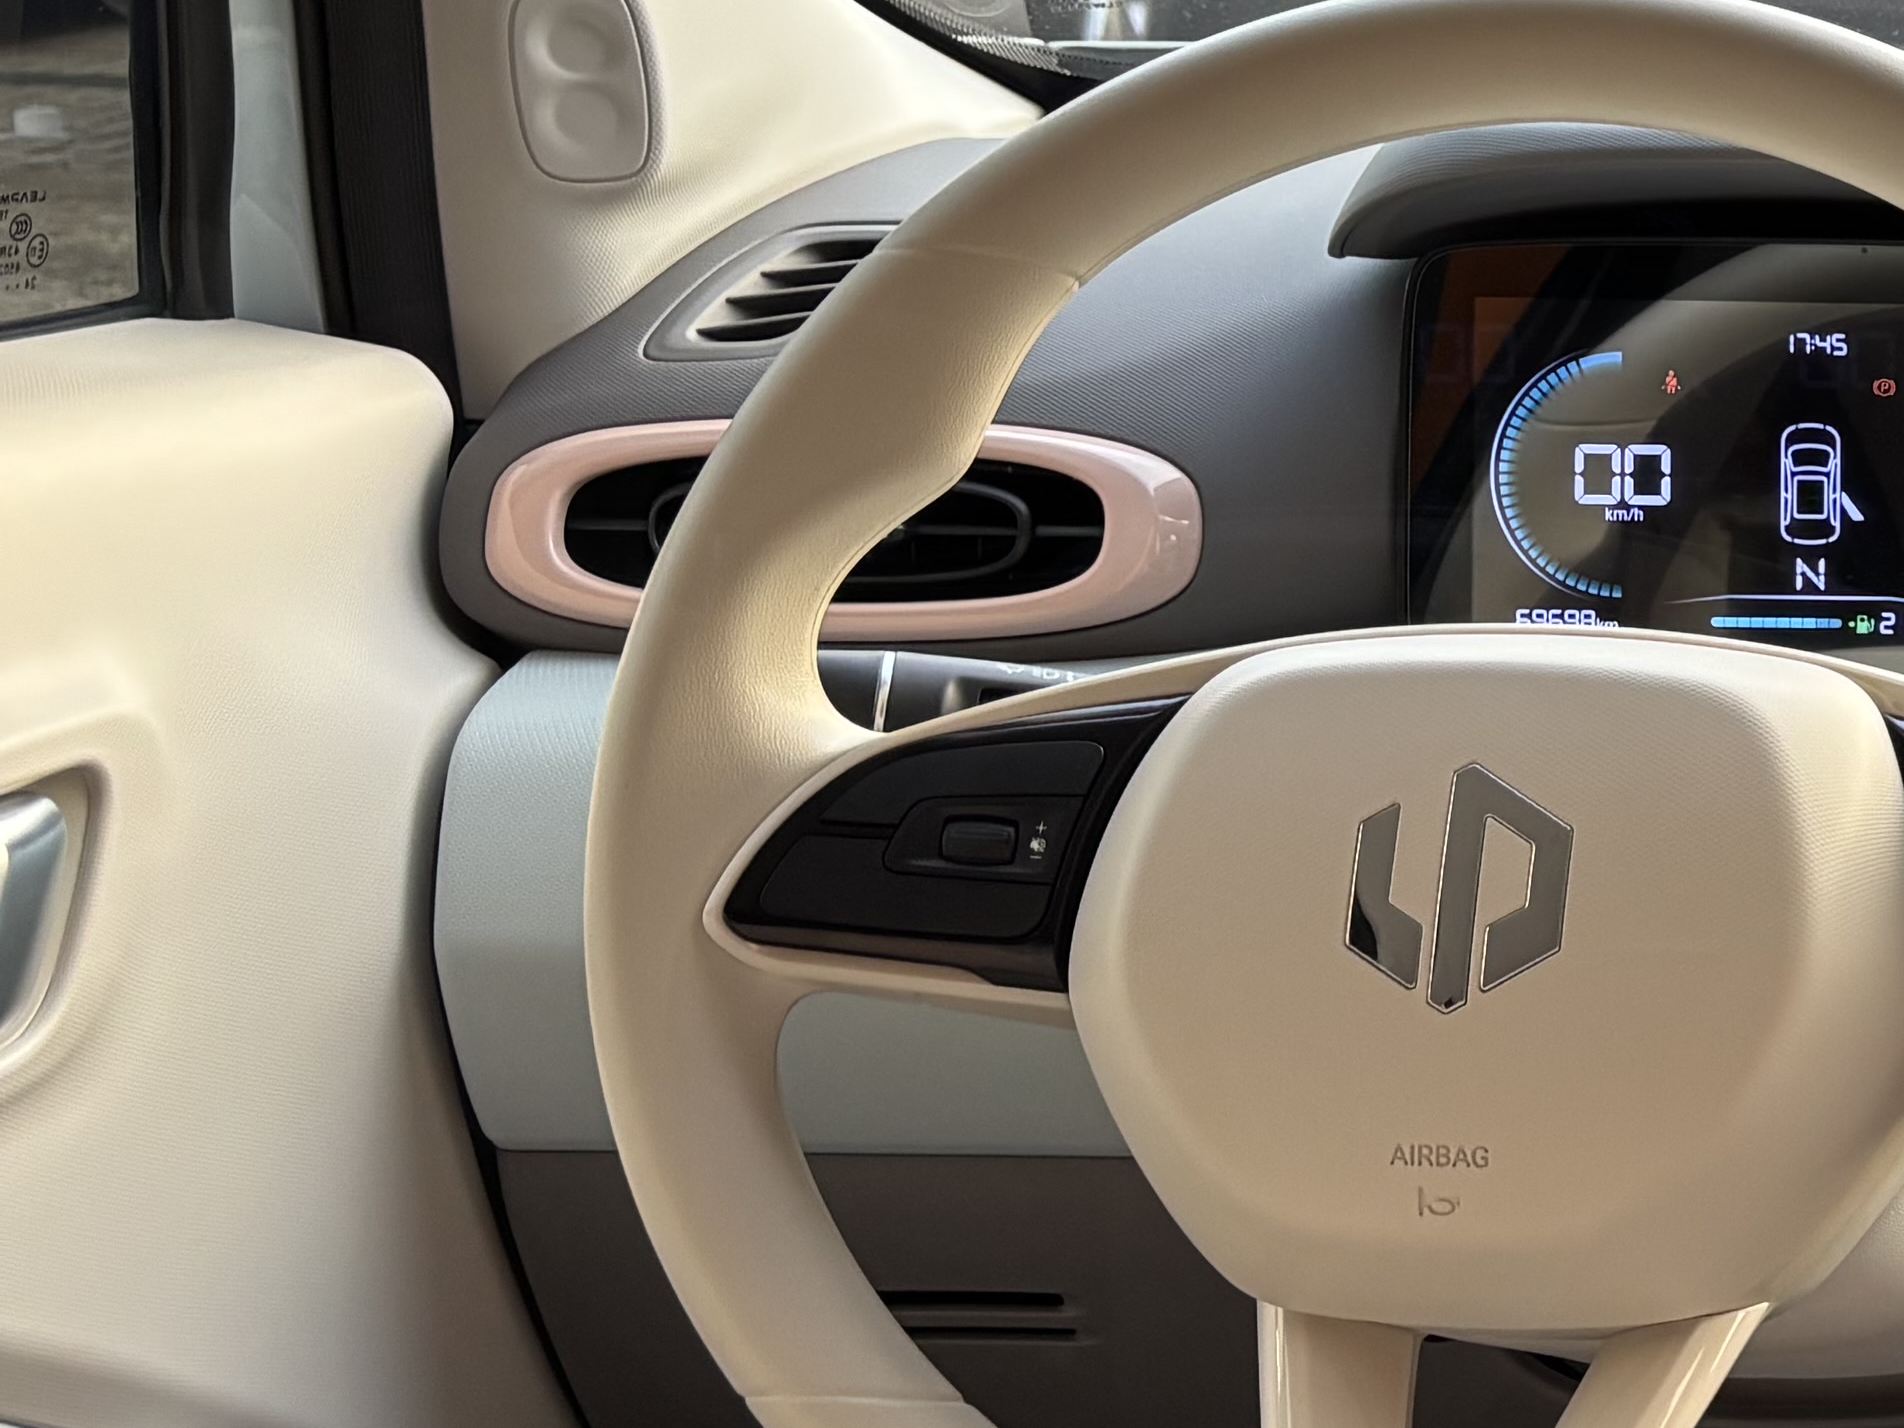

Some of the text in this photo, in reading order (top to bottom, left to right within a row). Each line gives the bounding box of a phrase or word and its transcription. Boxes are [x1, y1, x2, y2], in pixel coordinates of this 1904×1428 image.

[1789, 333, 1848, 356] 17:45
[1574, 443, 1672, 505] 00
[1605, 508, 1644, 522] km/h
[1796, 557, 1826, 591] N
[1390, 1143, 1490, 1169] AIRBAG
